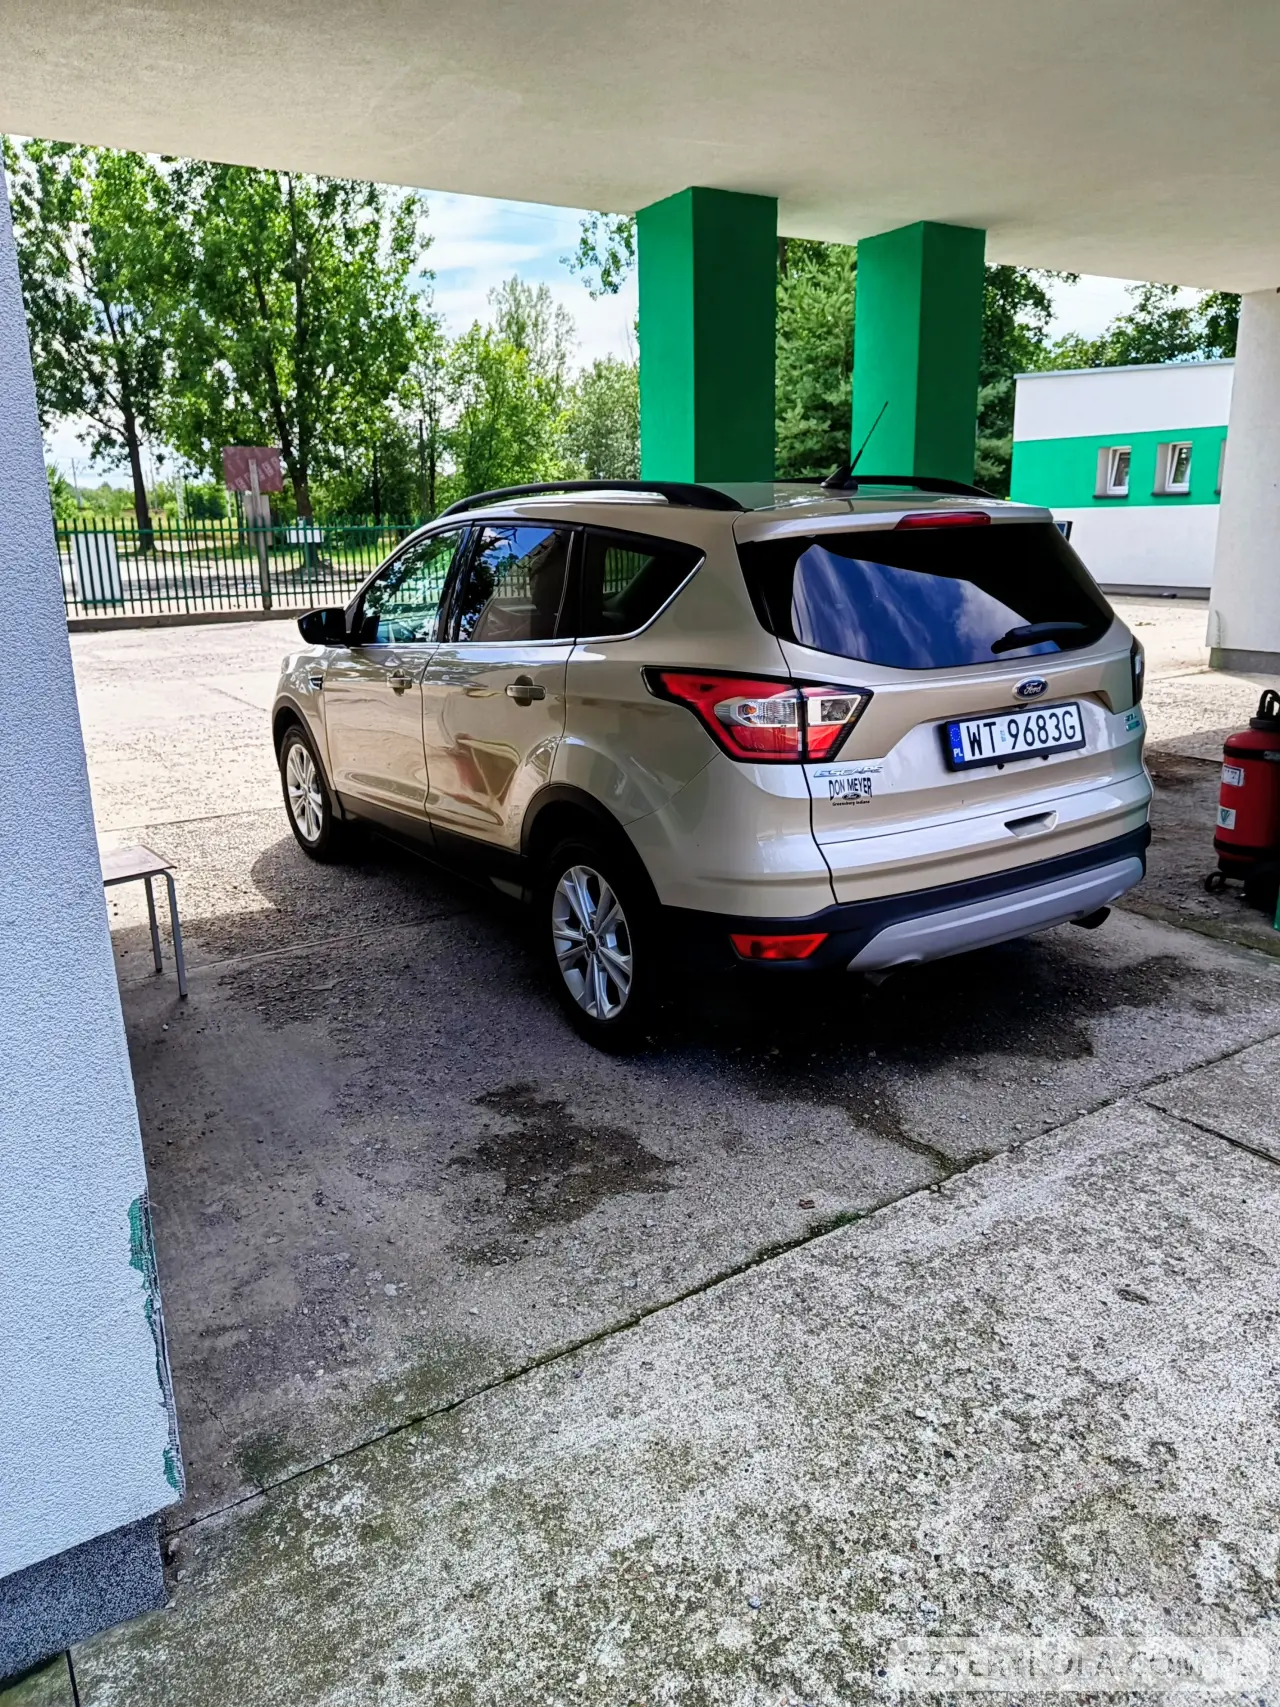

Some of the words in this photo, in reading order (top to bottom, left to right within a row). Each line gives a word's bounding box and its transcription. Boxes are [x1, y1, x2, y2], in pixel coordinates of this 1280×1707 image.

[1023, 682, 1043, 695] Ford
[967, 721, 996, 757] WT
[1007, 710, 1076, 750] 9683G
[953, 748, 963, 757] PL
[814, 766, 883, 777] ESCAPE
[828, 779, 845, 801] DON
[846, 777, 873, 798] MEYER
